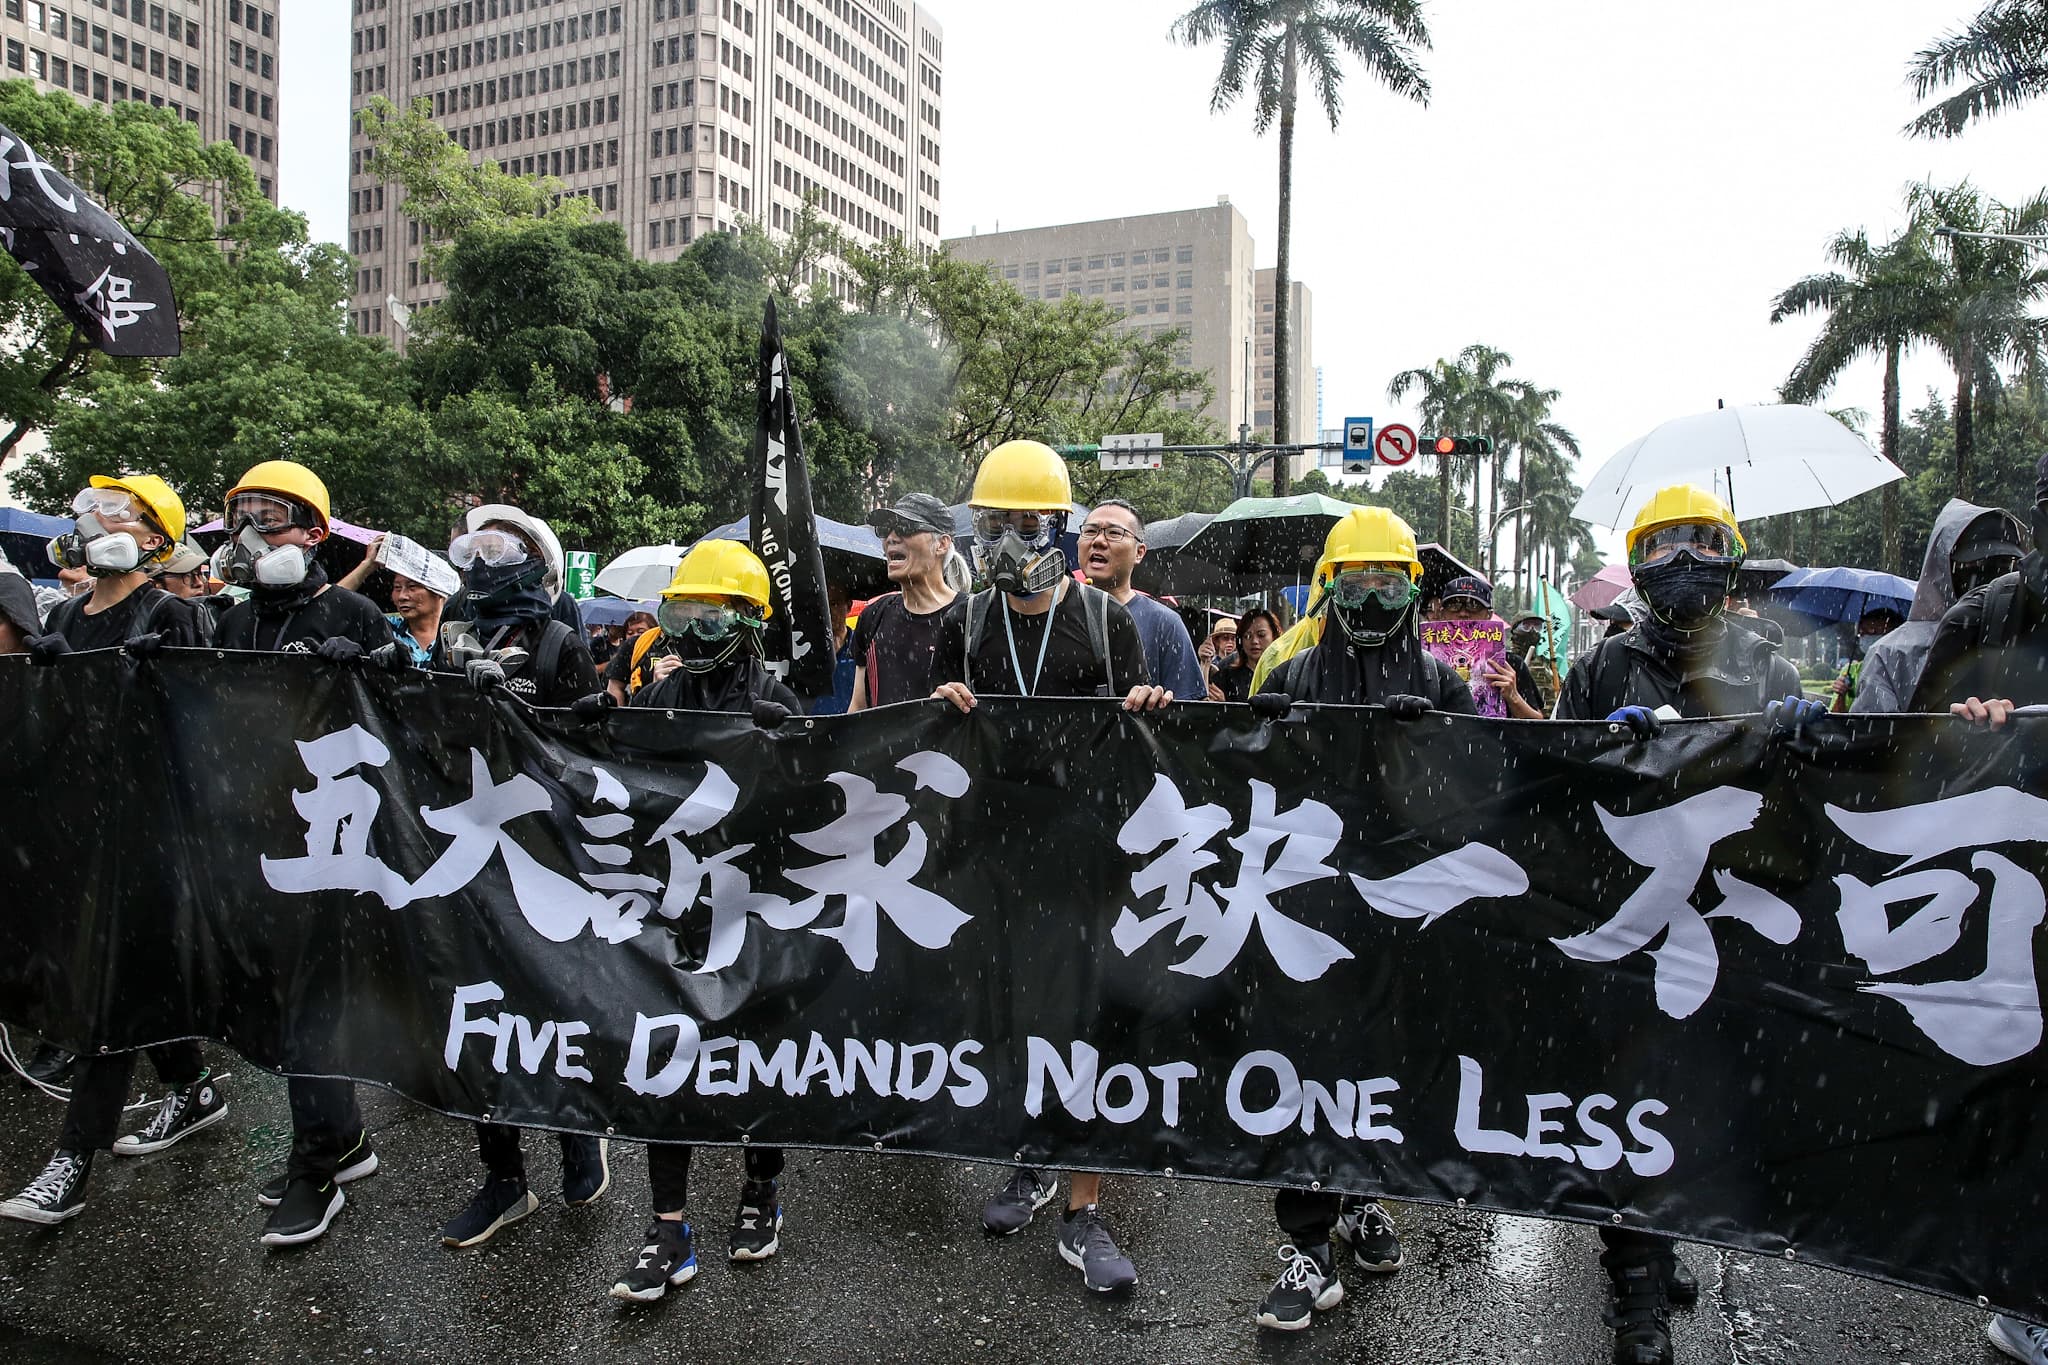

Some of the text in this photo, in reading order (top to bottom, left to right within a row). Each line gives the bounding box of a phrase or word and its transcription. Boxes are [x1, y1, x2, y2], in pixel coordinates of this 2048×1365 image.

[1422, 627, 1503, 644] 香港人加油
[261, 723, 2048, 1066] 五大訴求 缺一不可
